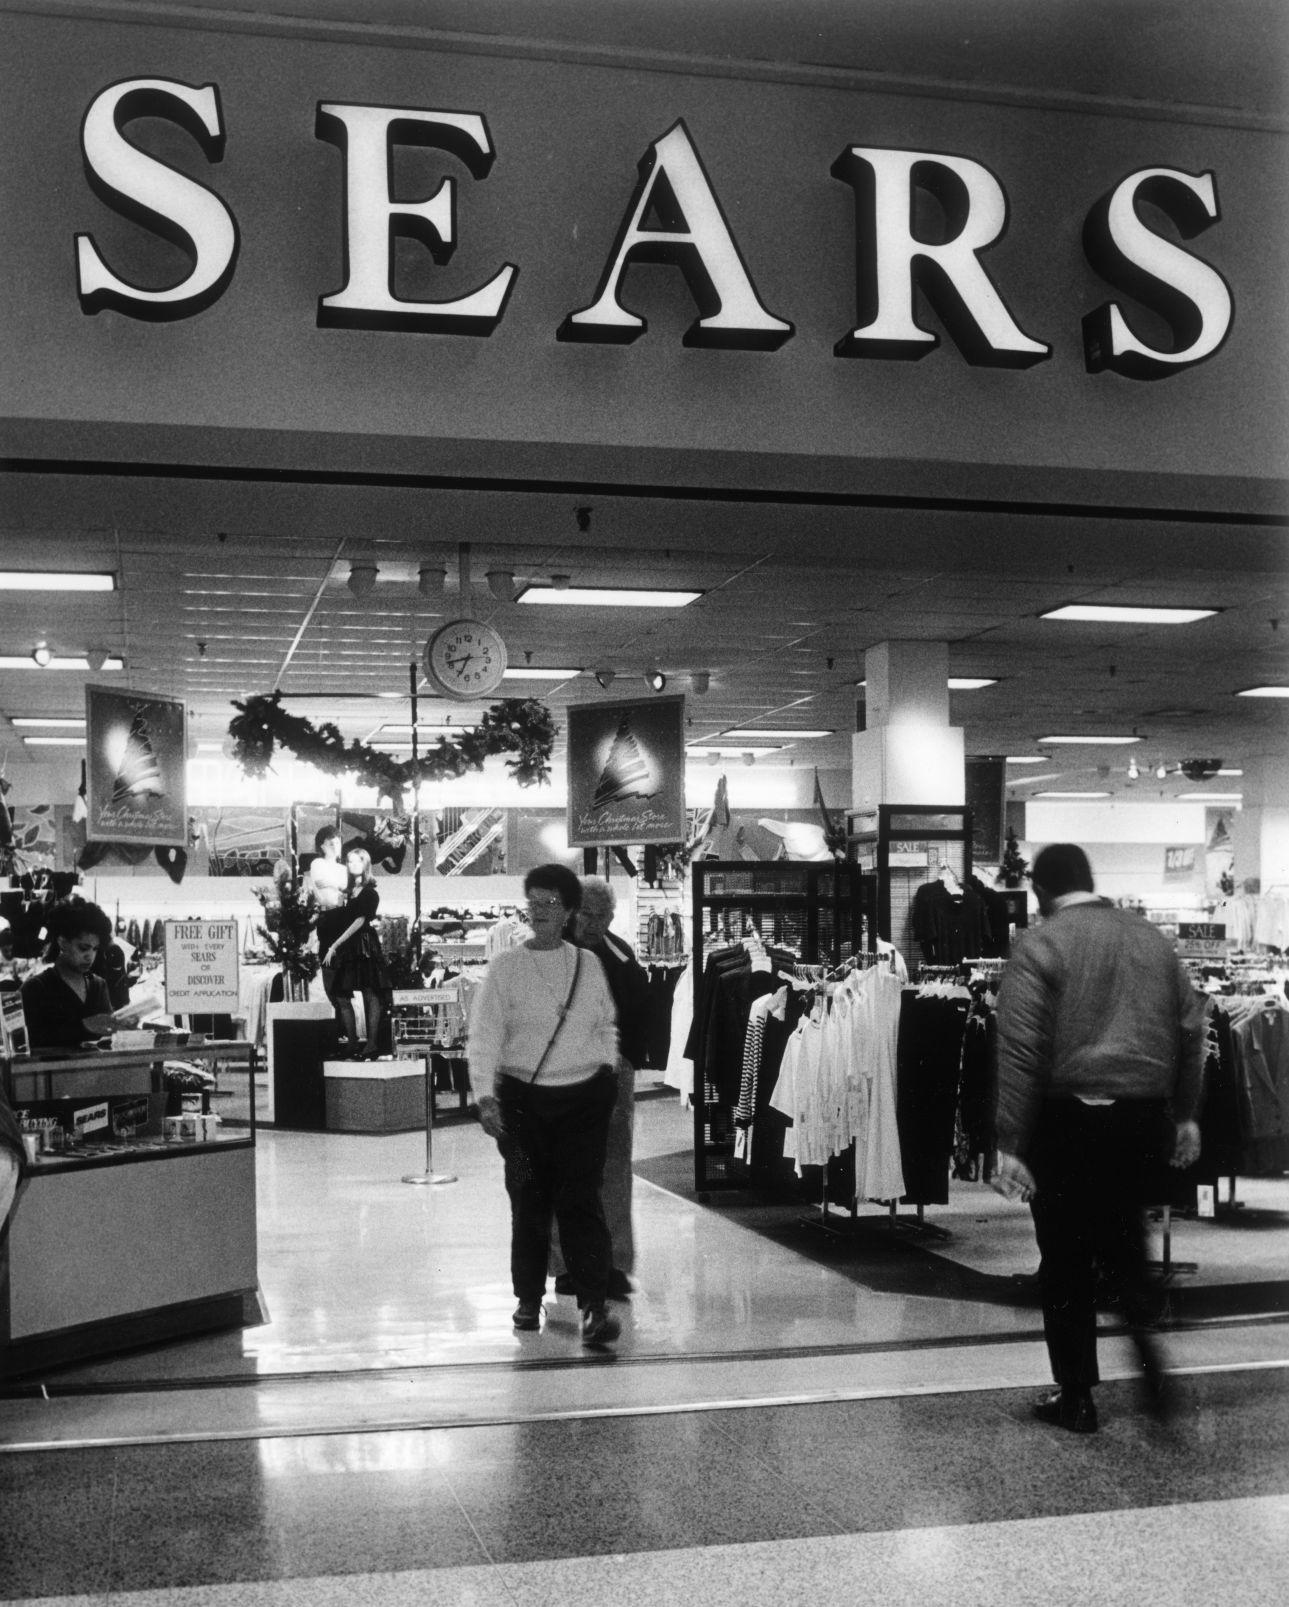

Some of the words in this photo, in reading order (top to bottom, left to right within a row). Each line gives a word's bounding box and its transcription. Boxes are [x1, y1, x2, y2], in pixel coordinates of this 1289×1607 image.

[77, 78, 1233, 368] SEARS
[464, 634, 472, 642] 12
[445, 652, 451, 660] 9
[483, 647, 489, 655] 2
[116, 805, 152, 819] Christmas
[578, 812, 596, 830] Your
[598, 810, 639, 826] Christmas
[639, 809, 666, 824] Store
[897, 842, 920, 853] SALE
[174, 925, 203, 940] FREE
[208, 925, 234, 940] GIFT
[1189, 924, 1216, 938] SALE
[191, 952, 216, 962] SEARS
[187, 975, 225, 985] DISCOVER
[76, 1108, 107, 1125] SEARS
